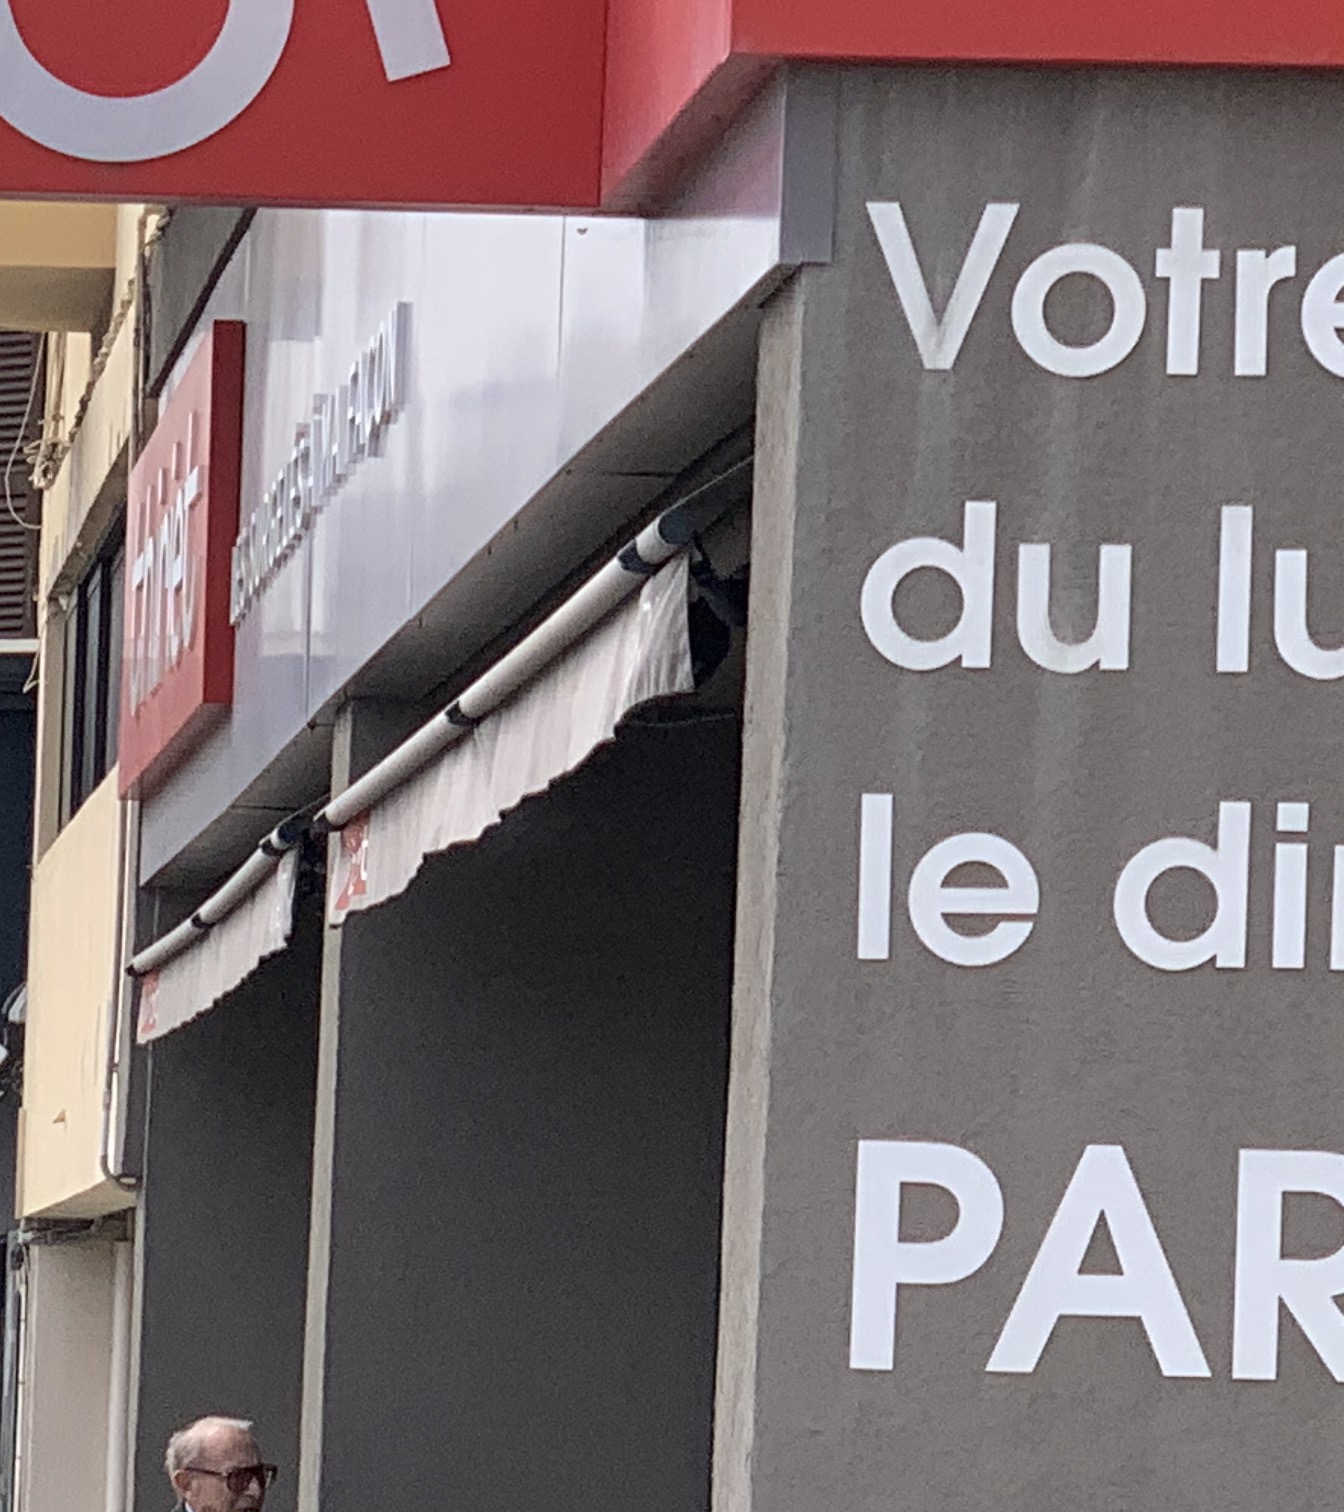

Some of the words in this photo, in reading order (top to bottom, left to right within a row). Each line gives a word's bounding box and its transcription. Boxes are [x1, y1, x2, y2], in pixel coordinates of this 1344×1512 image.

[859, 500, 1132, 674] du
[856, 792, 1041, 967] le
[1114, 801, 1344, 972] di
[848, 1138, 1344, 1382] PAR
